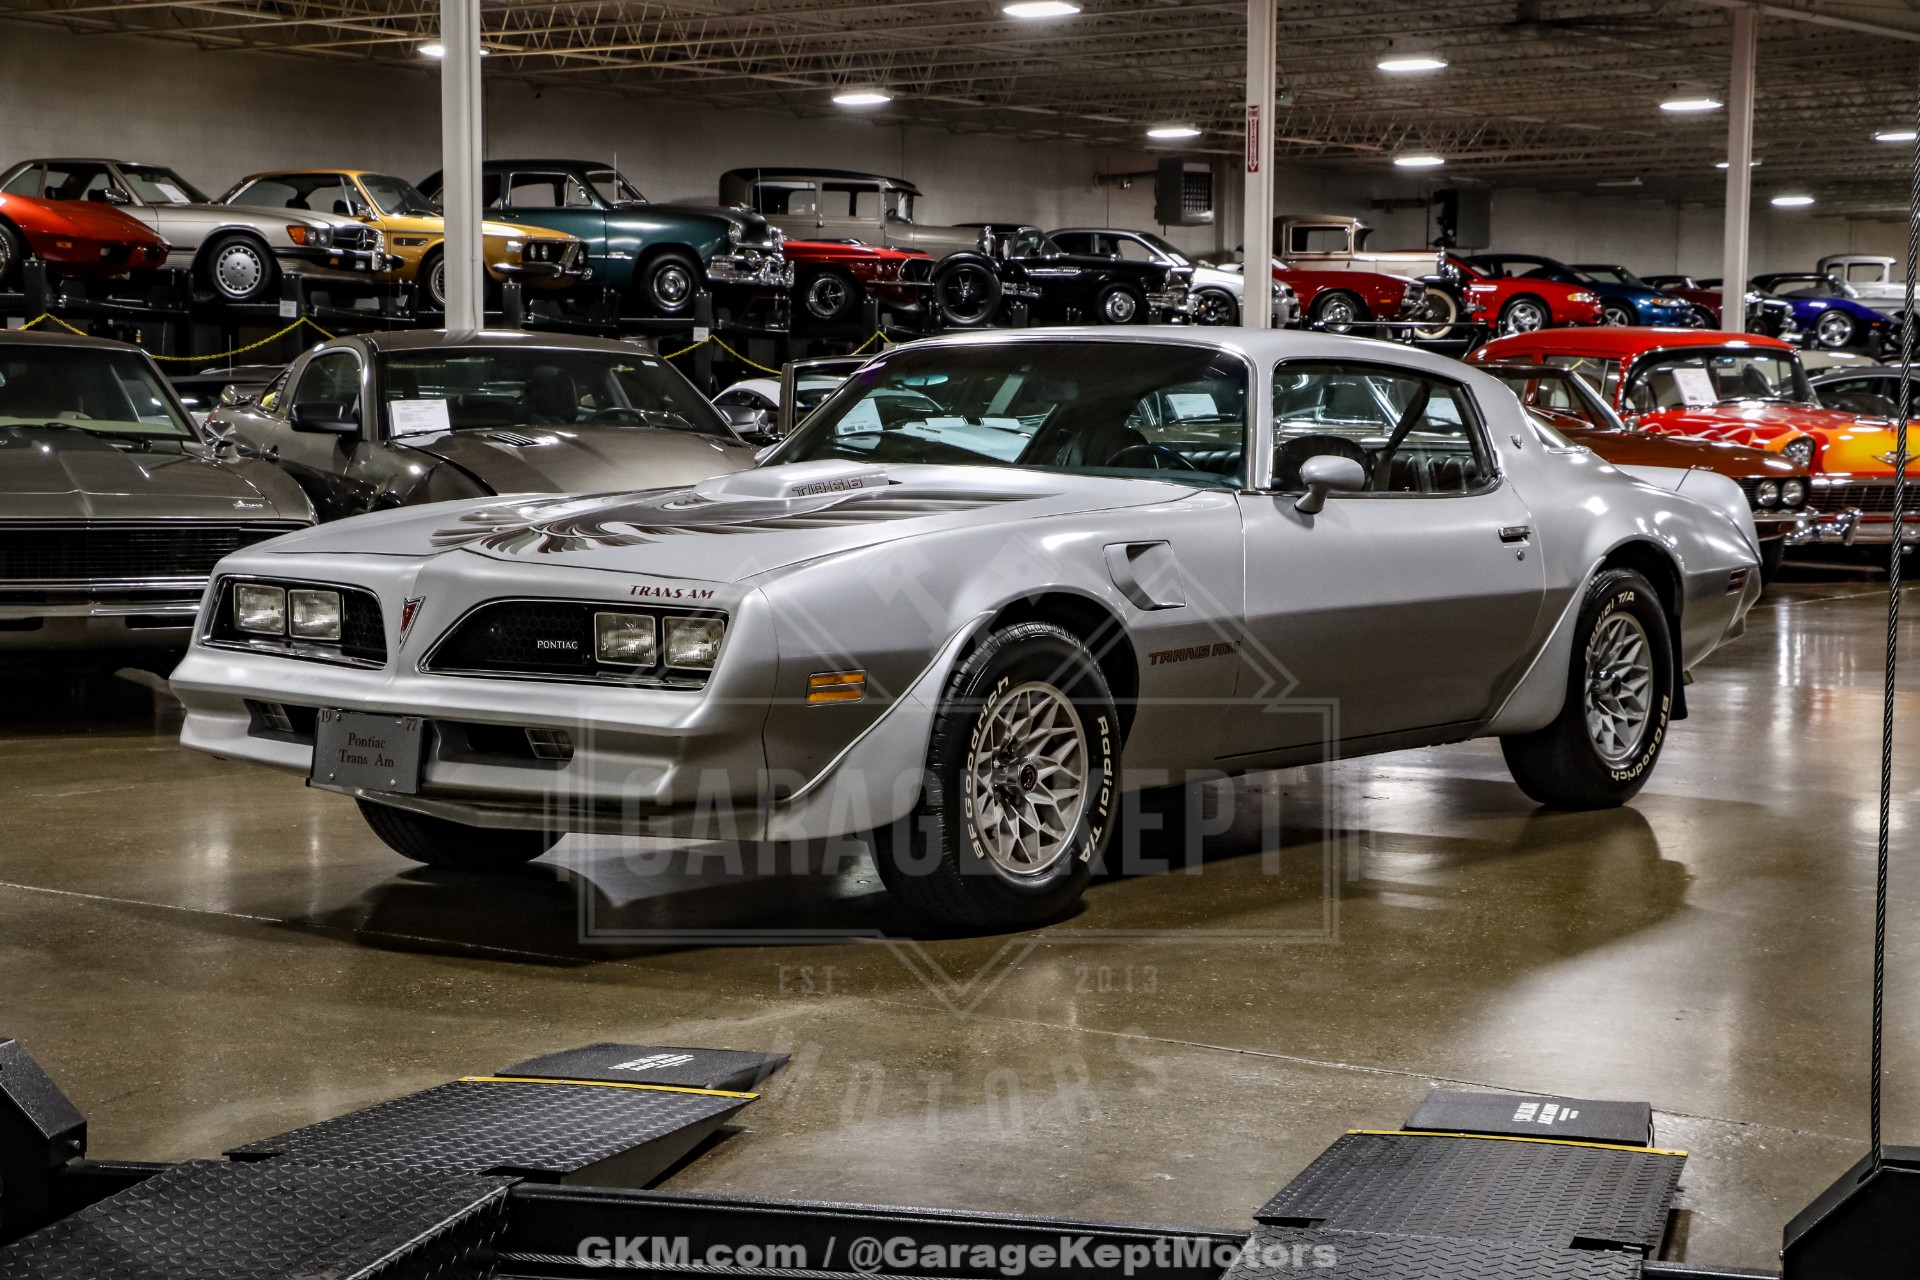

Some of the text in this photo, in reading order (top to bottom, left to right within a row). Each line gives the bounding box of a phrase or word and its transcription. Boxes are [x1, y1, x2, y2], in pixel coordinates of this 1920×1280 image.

[630, 585, 715, 600] TRANS AM
[1618, 591, 1635, 604] T/A
[537, 640, 578, 650] PONTIAC
[1148, 644, 1211, 666] TRANS
[320, 710, 418, 732] 19 77
[347, 732, 386, 749] Pontiac
[1611, 695, 1669, 782] BFGoodrich
[339, 749, 395, 768] Trans Am
[965, 676, 1009, 859] BFGoodrich
[1078, 716, 1113, 863] Radial T/A
